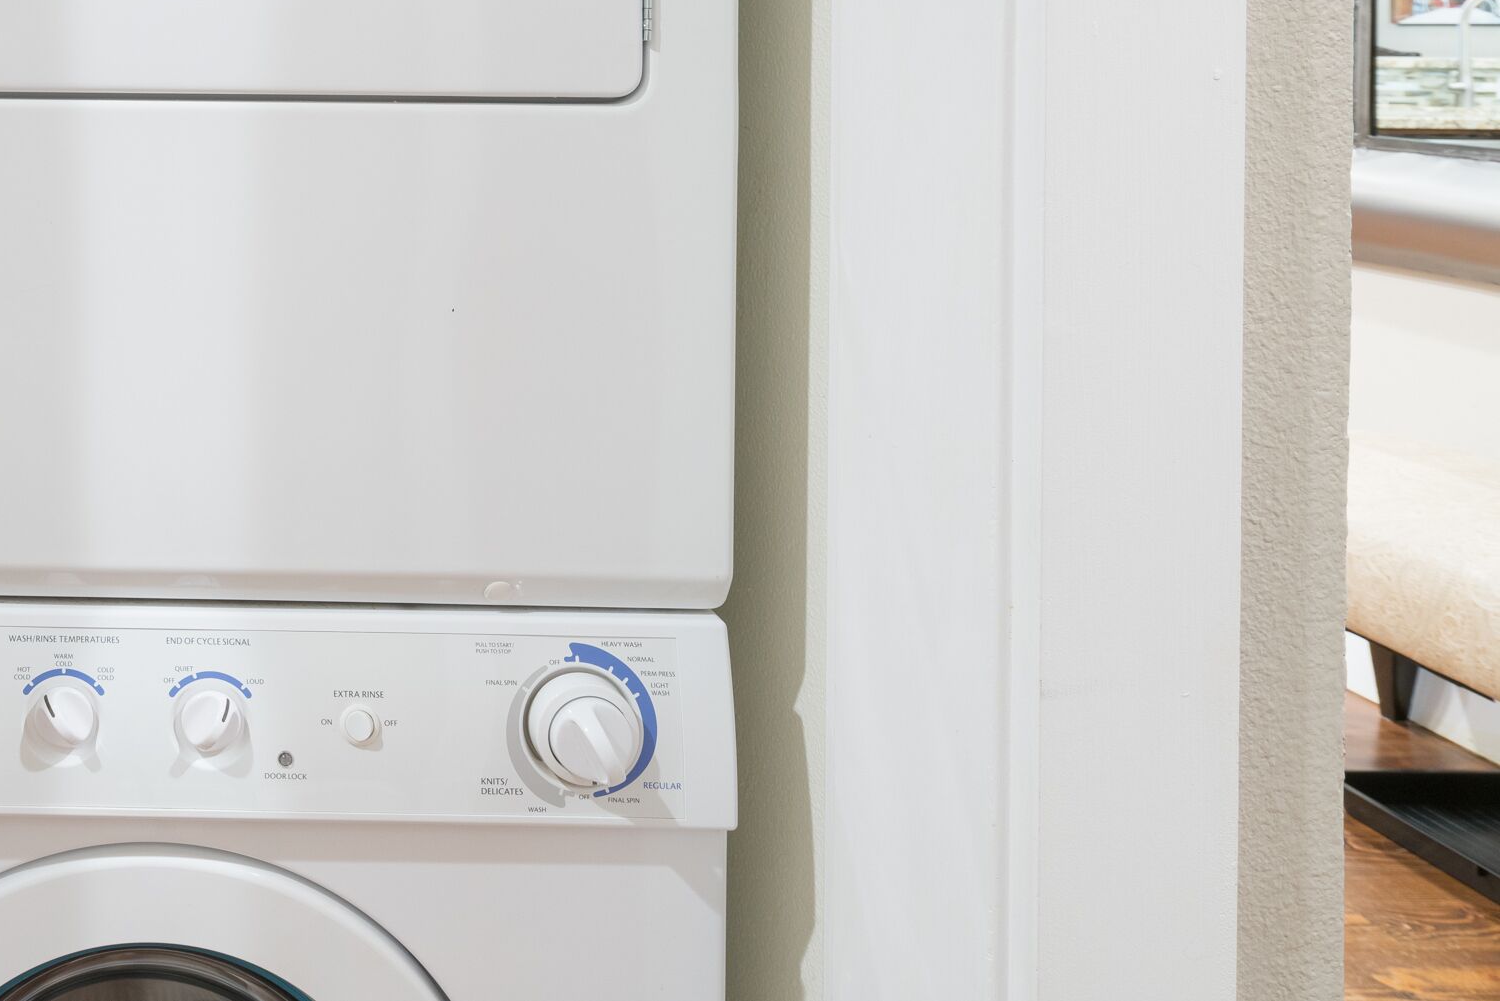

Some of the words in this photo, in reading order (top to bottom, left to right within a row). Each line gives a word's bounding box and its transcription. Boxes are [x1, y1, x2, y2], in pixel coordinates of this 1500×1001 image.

[8, 635, 57, 643] WASH/RINSE
[58, 635, 120, 644] TEMPERATURES
[166, 637, 182, 645] END
[184, 637, 195, 645] OF
[222, 638, 251, 646] SIGNAL
[333, 690, 360, 698] EXTRA
[361, 690, 384, 699] RINSE
[481, 777, 508, 786] KNITS/
[643, 781, 682, 790] REGULAR
[481, 787, 524, 796] DELICATES
